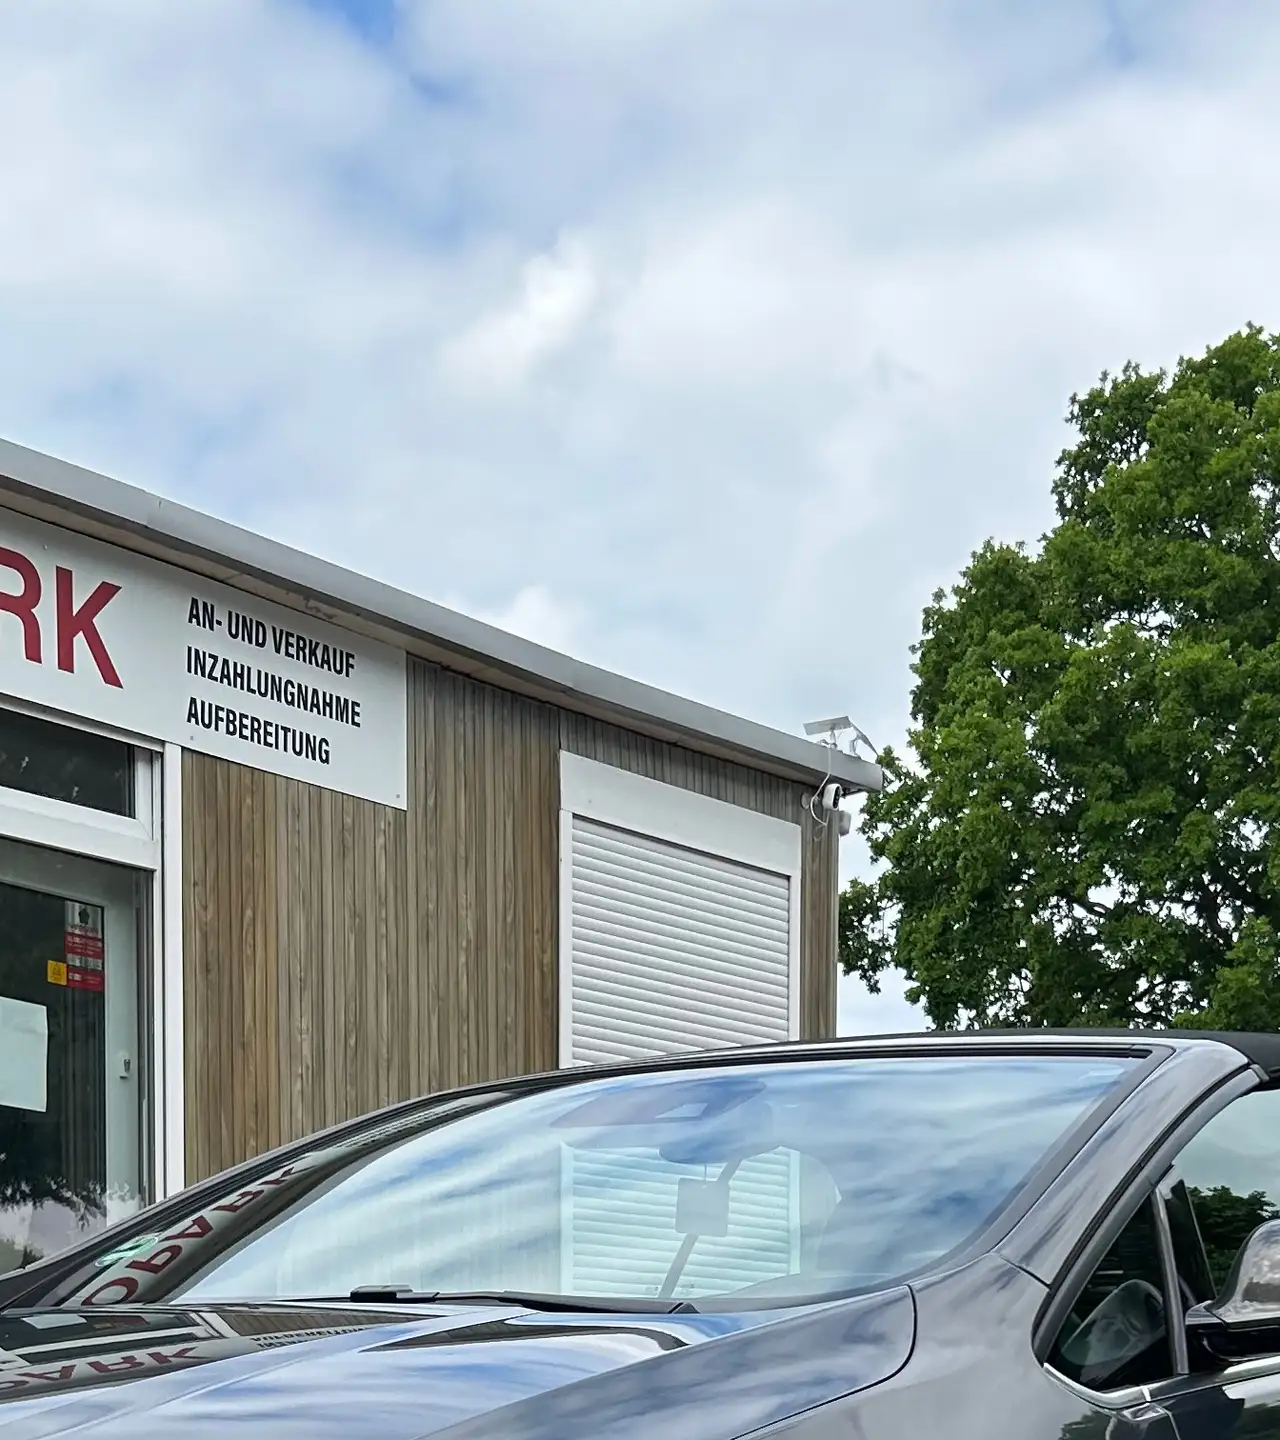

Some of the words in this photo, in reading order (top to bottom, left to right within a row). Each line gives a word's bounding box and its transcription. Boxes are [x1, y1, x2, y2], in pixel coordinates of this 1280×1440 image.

[188, 597, 223, 632] AN-
[227, 609, 268, 648] UND
[271, 625, 355, 678] VERKAUF
[186, 646, 361, 727] INZAHLUNGNAHME
[186, 697, 330, 765] AUFBEREITUNG
